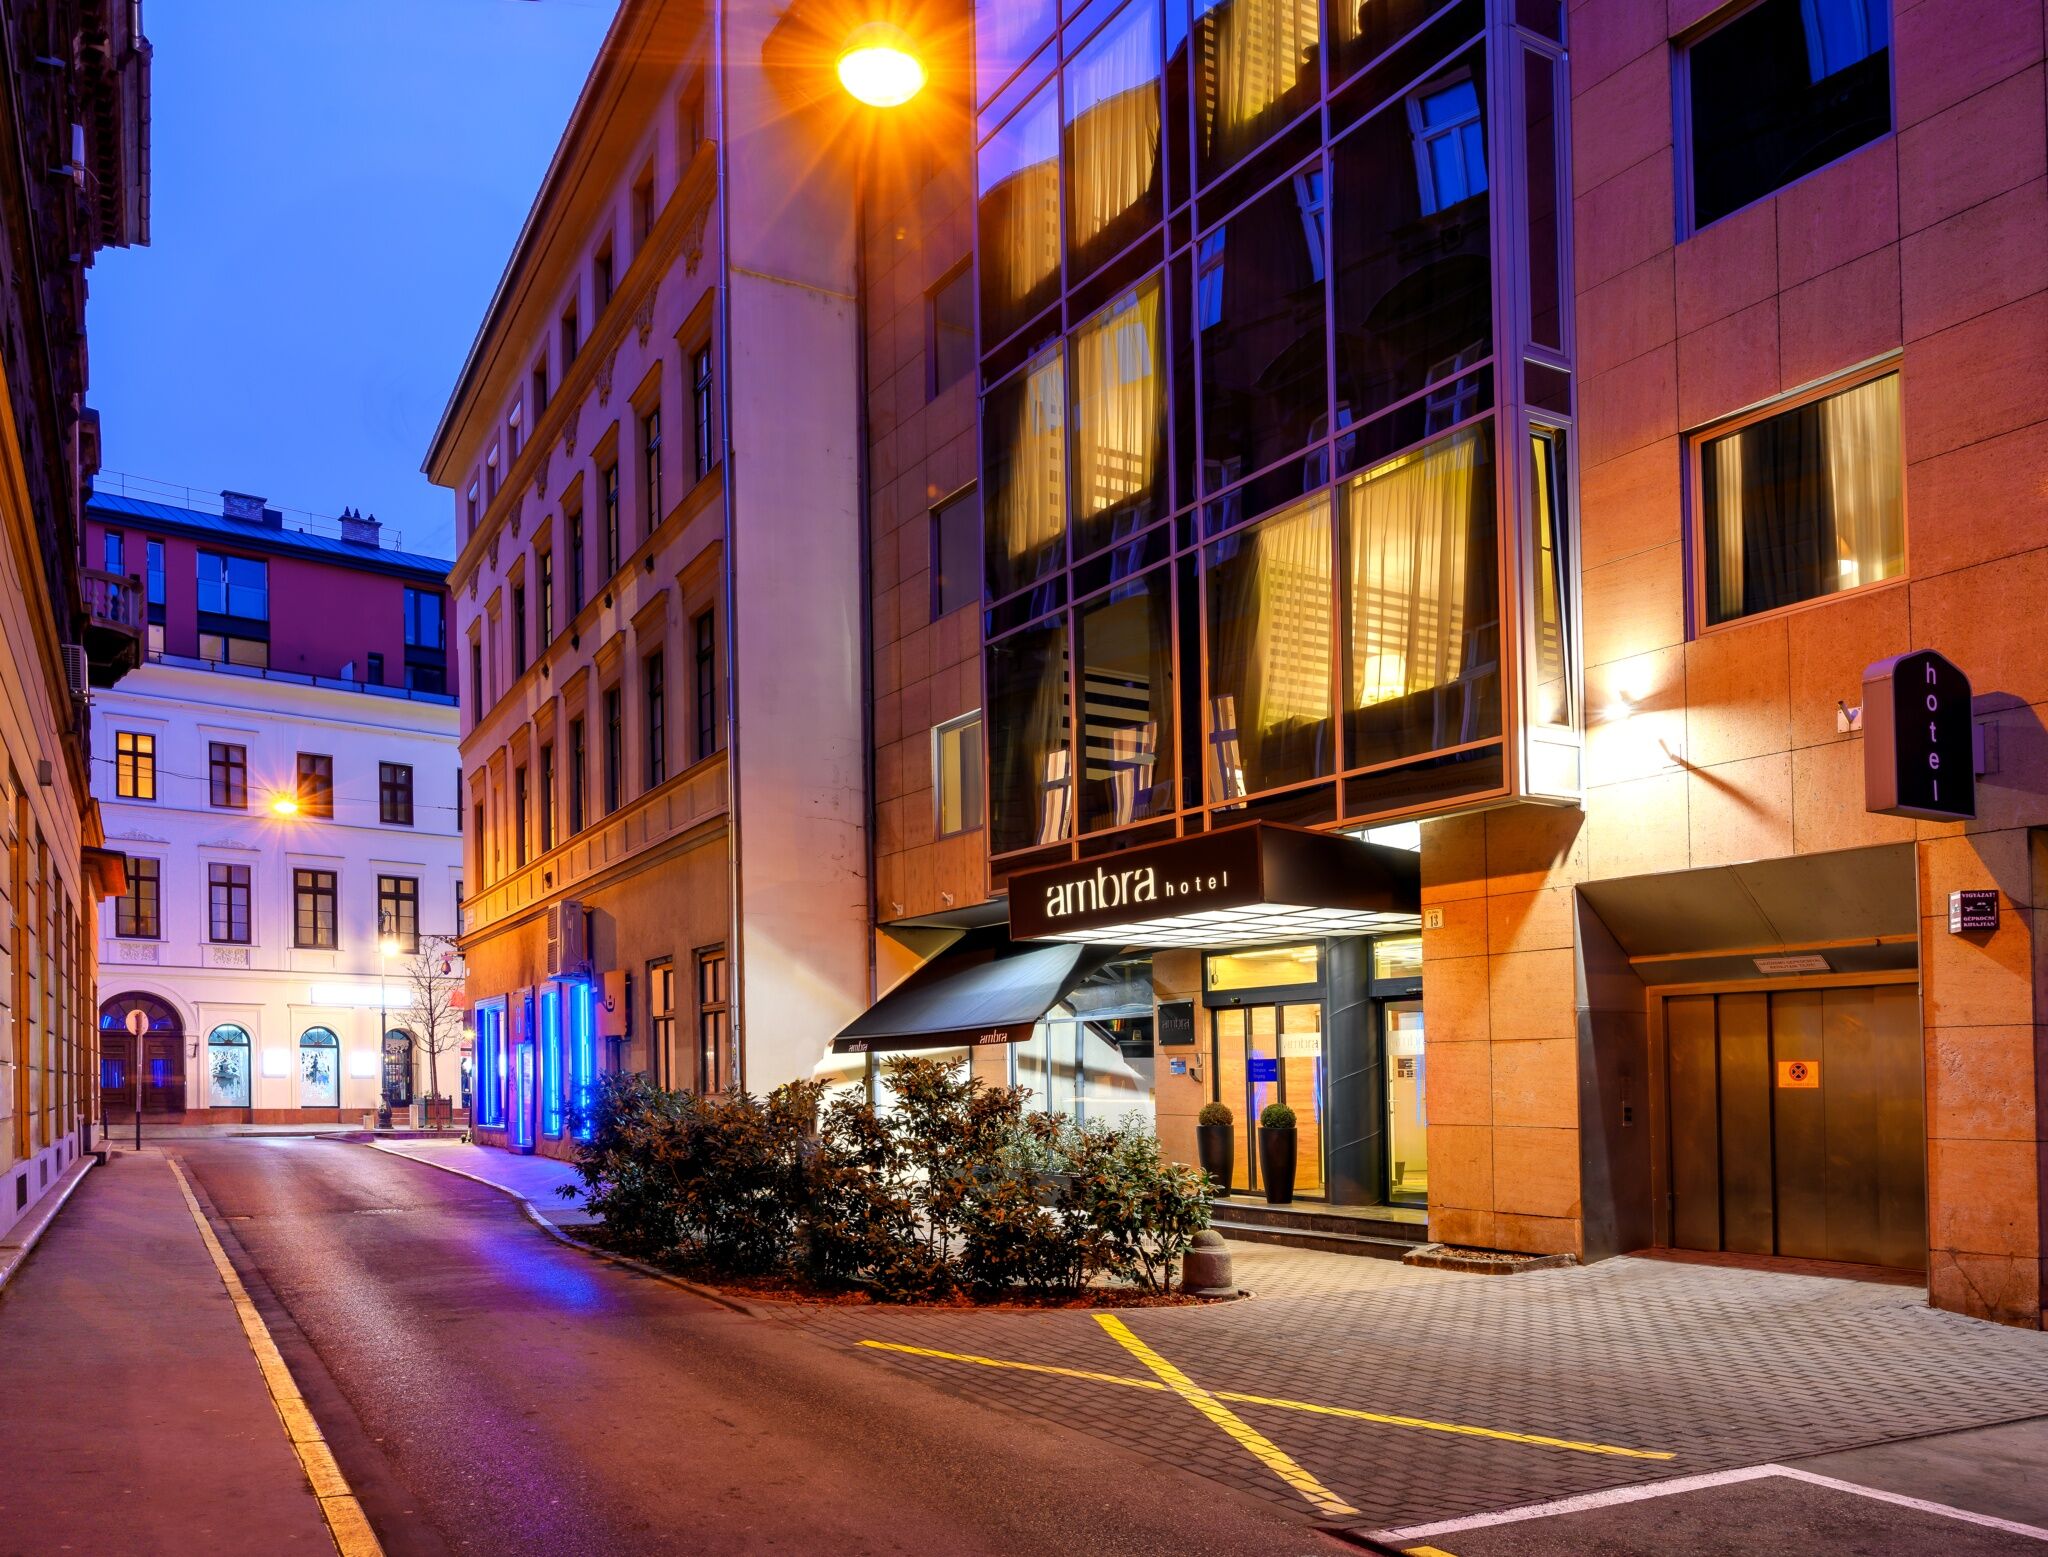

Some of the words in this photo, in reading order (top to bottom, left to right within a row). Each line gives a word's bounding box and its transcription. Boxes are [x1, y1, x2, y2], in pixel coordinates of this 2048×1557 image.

[1926, 661, 1940, 801] hotel
[1046, 866, 1158, 918] ambra
[1166, 871, 1228, 897] hotel
[1430, 914, 1439, 927] 13
[1162, 1015, 1190, 1031] ambra
[979, 1029, 1008, 1044] ambra
[848, 1040, 869, 1052] ambra
